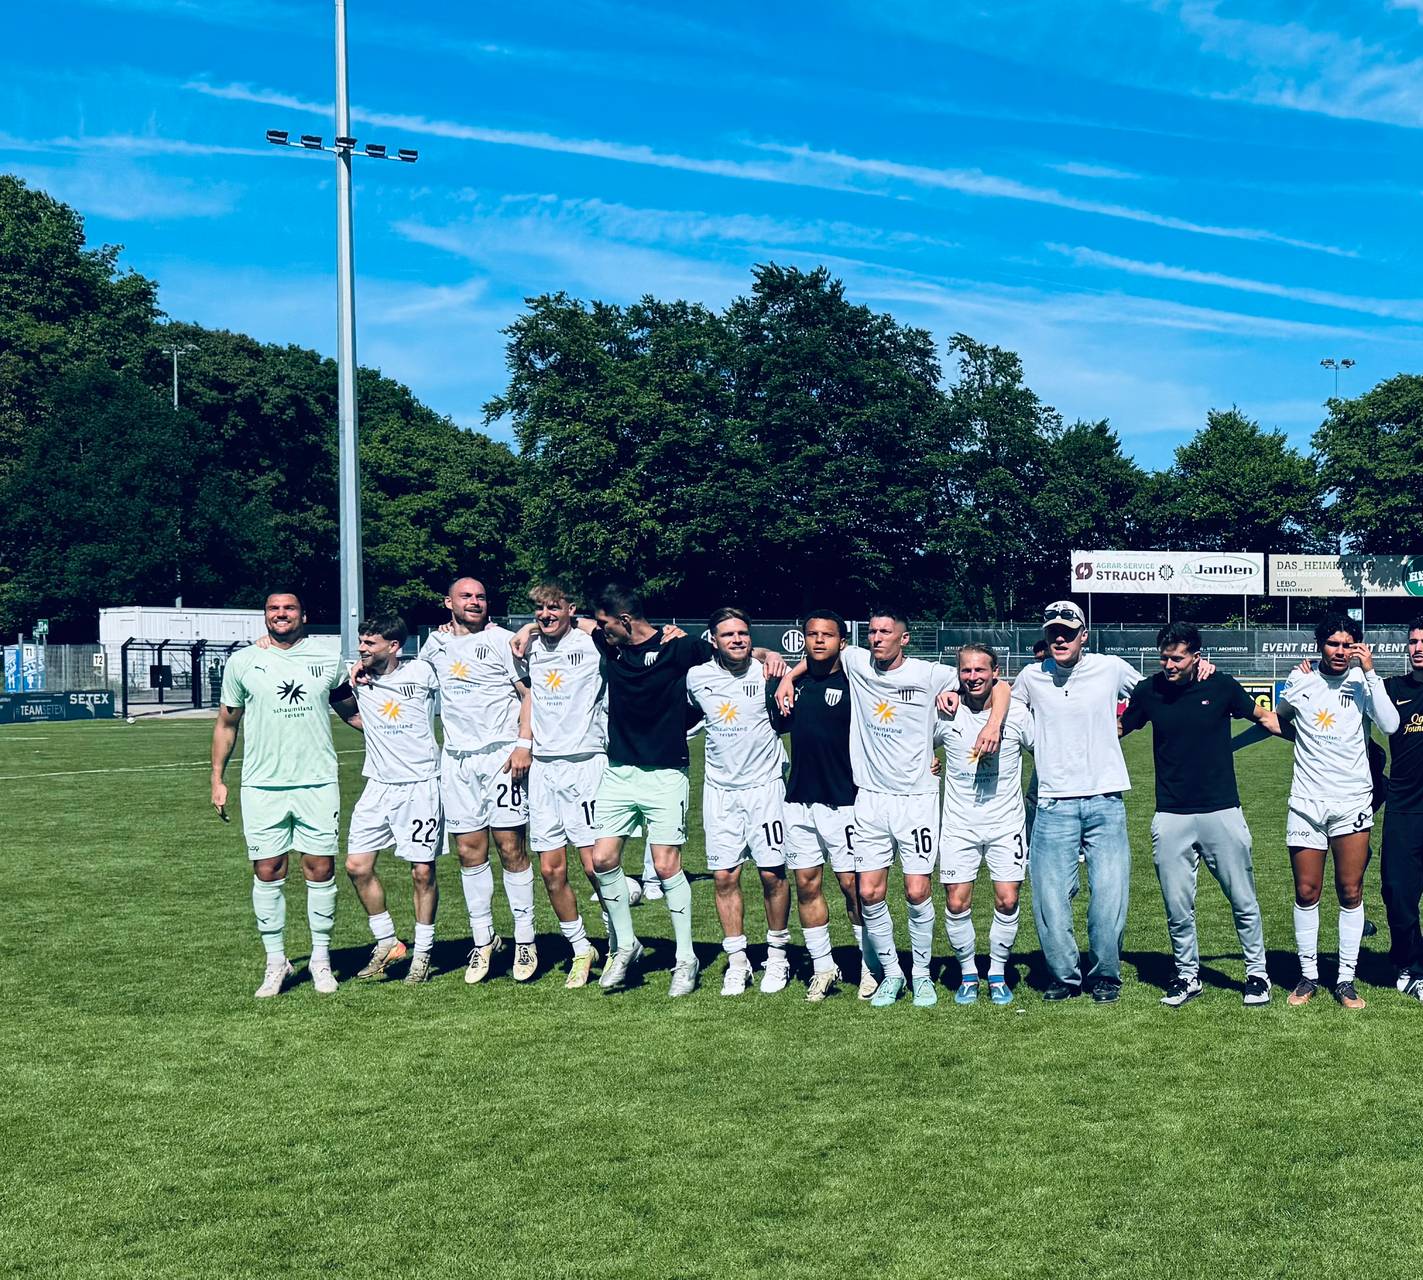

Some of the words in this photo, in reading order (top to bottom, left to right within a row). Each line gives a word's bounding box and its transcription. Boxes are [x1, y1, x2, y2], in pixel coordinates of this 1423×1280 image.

[1096, 562, 1155, 570] AGRAR-SERVICE
[1194, 564, 1253, 575] Janßen
[1096, 571, 1155, 582] STRAUCH
[1262, 643, 1298, 652] EVENT
[1300, 643, 1318, 652] RE
[1378, 643, 1407, 652] RENT
[69, 693, 109, 705] SETEX
[496, 783, 522, 808] 28
[411, 818, 437, 843] 22
[761, 820, 783, 847] 10
[910, 827, 932, 854] 16
